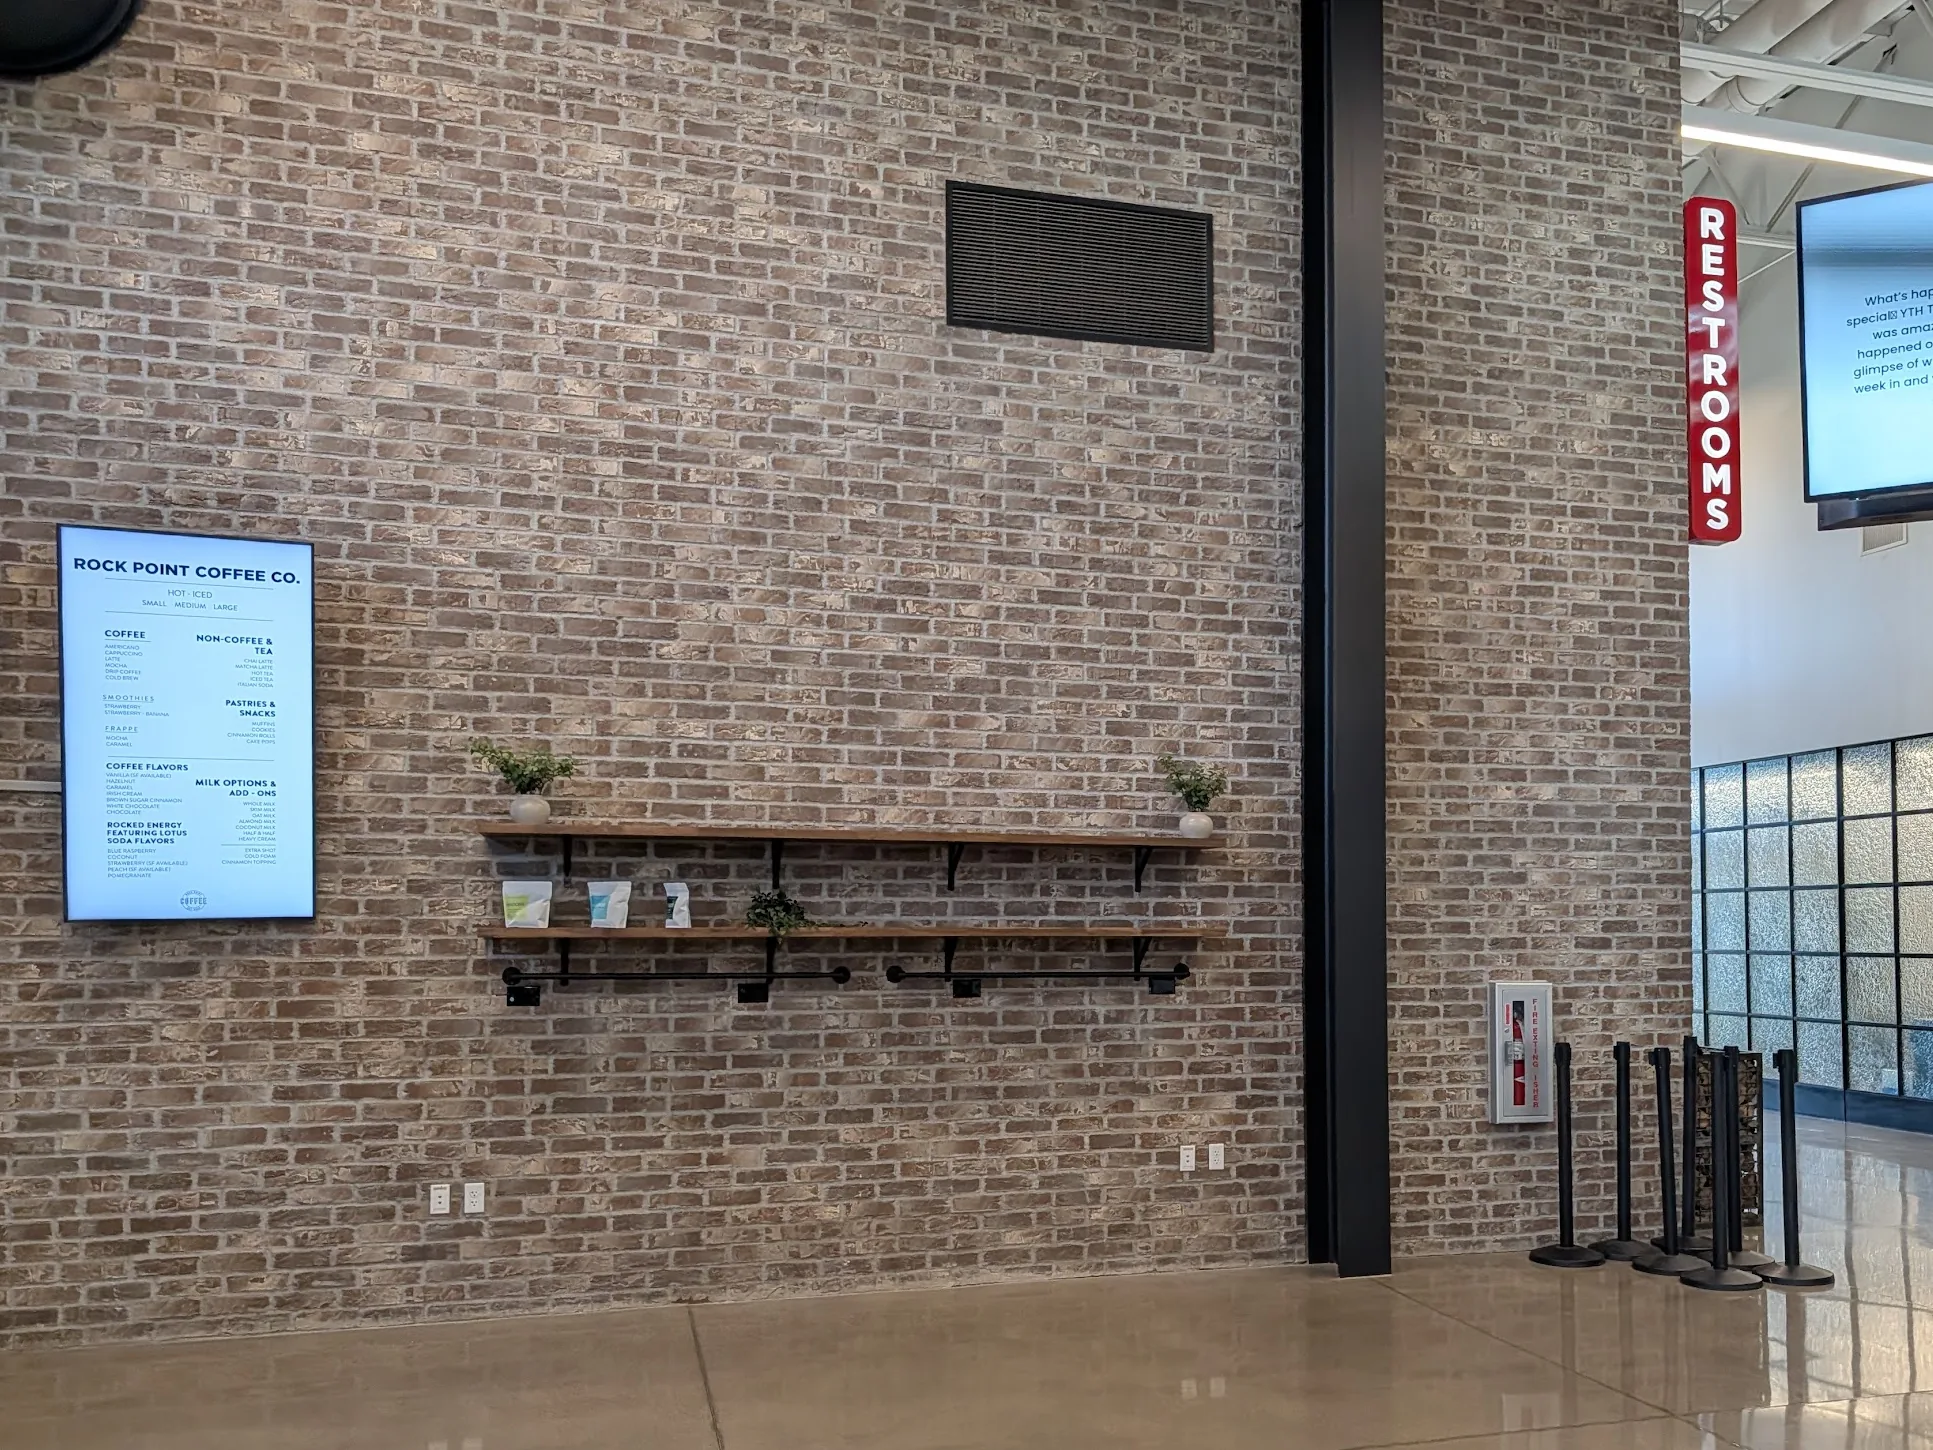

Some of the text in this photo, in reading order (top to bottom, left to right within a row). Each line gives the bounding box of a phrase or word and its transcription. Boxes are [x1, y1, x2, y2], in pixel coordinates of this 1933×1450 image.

[1864, 292, 1908, 306] What's
[1900, 306, 1924, 318] YTH
[1872, 323, 1933, 339] was ama
[1857, 340, 1922, 359] happened
[1699, 207, 1731, 531] RESTROOMS
[1853, 362, 1903, 379] glimpse
[1907, 358, 1918, 368] of
[1853, 374, 1928, 393] week in and
[73, 557, 301, 584] ROCK POINT COFFEE CO.
[167, 589, 186, 597] HOT
[192, 590, 213, 599] ICED
[142, 599, 238, 611] SMALL MEDIUM LARGE
[104, 629, 146, 639] COFFEE
[196, 634, 273, 646] NON-COFFEE &
[254, 646, 273, 655] TEA
[102, 694, 155, 702] SMOOTHIES
[225, 699, 267, 708] PASTRIES
[239, 709, 276, 718] SNACKS
[105, 762, 189, 771] COFFEE FLAVORS
[195, 778, 221, 787] MILK
[222, 779, 268, 787] OPTIONS
[228, 789, 249, 797] ADD
[107, 821, 183, 829] ROCKED ENERGY
[106, 829, 158, 837] FEATURING
[180, 897, 207, 905] COFFEE
